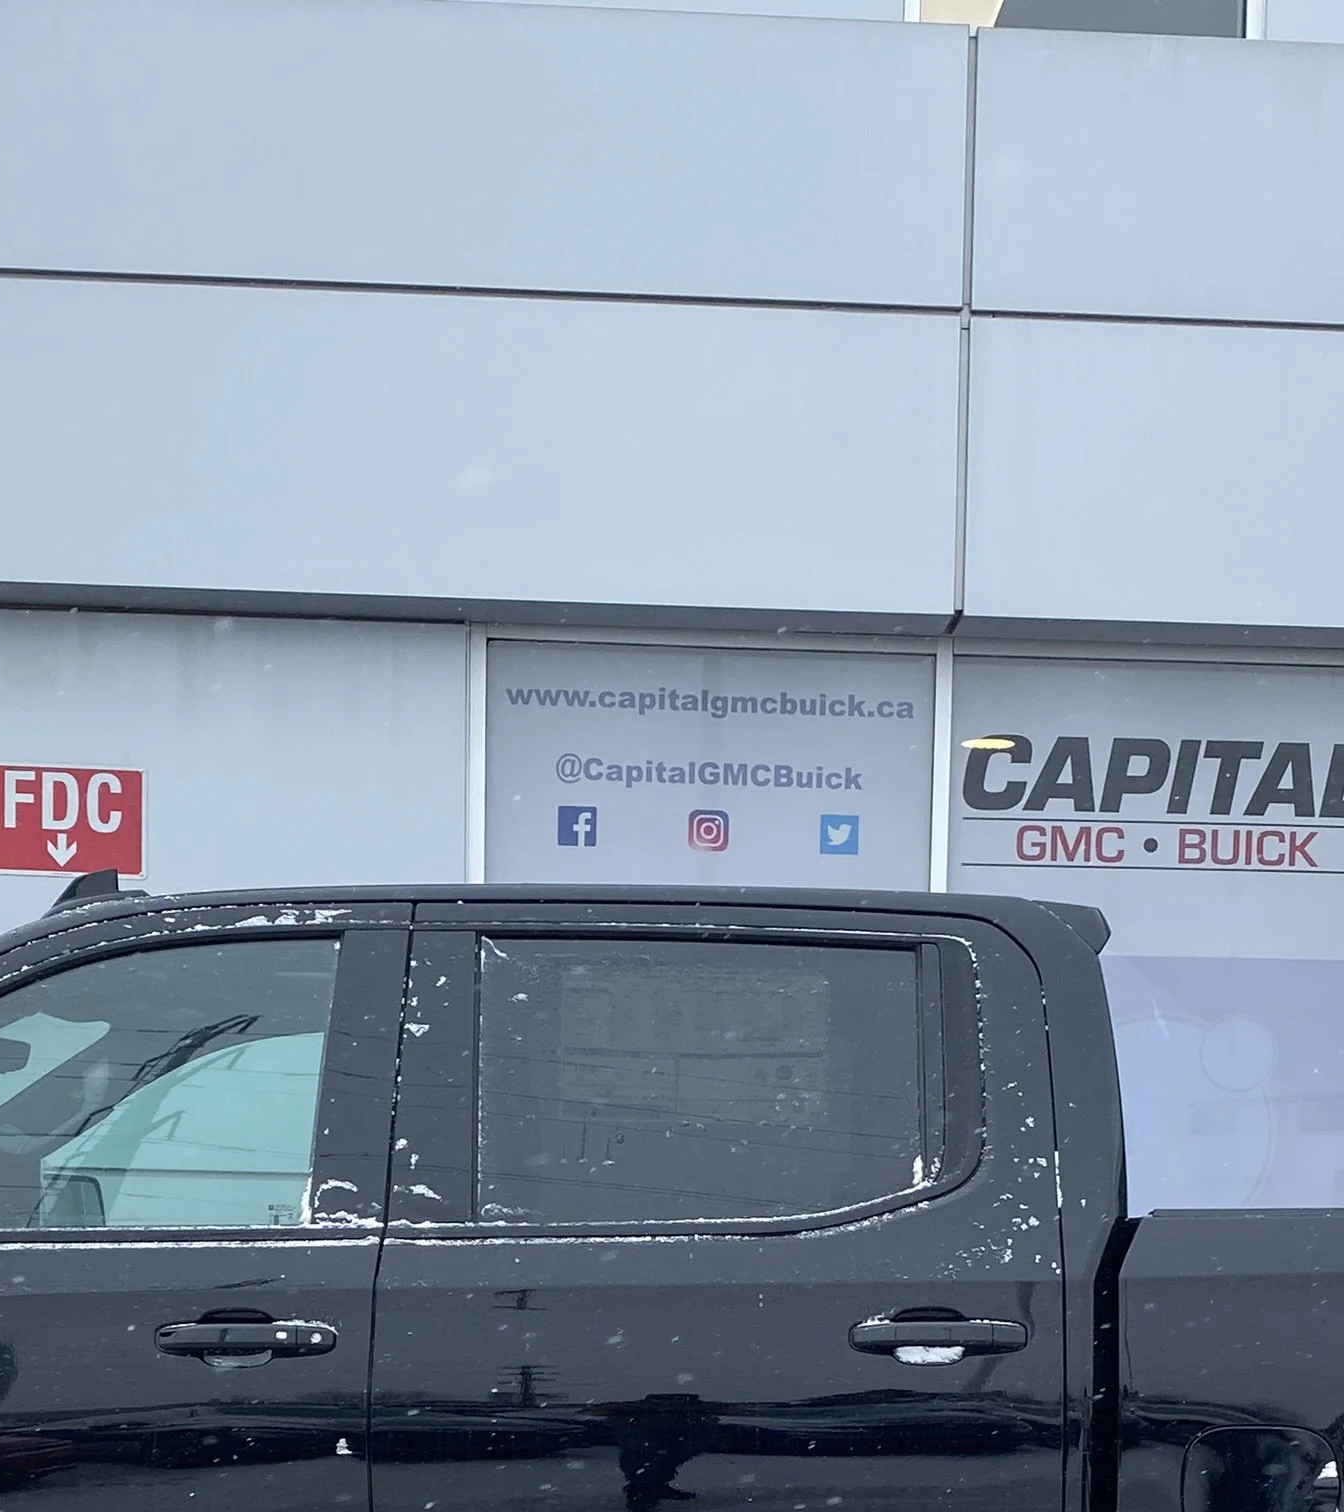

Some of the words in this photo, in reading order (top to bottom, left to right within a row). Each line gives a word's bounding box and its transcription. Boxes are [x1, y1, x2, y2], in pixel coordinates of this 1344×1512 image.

[506, 686, 915, 720] www.capitalgmcbuick.ca
[556, 753, 863, 790] @CapitalGMCBuick
[4, 769, 123, 834] FDC
[1015, 824, 1125, 864] GMC
[1177, 828, 1319, 868] BUICK
